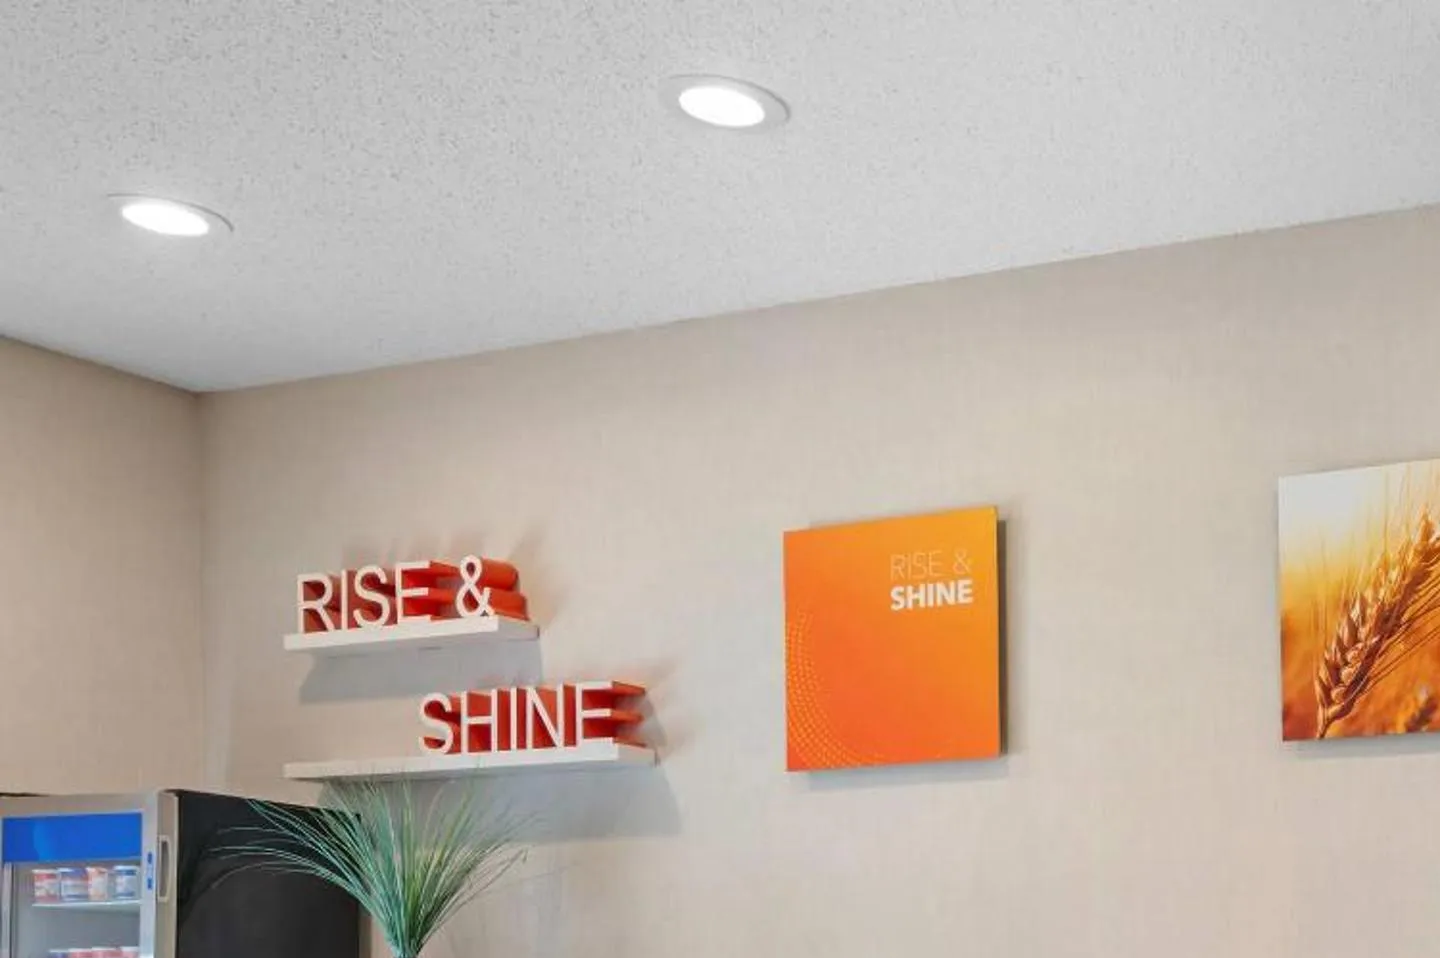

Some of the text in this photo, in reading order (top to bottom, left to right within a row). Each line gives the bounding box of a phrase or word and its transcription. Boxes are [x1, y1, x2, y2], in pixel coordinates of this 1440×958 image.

[890, 547, 971, 580] RISE &
[297, 554, 496, 632] RISE &
[890, 579, 974, 611] SHINE
[419, 681, 614, 754] SHINE
